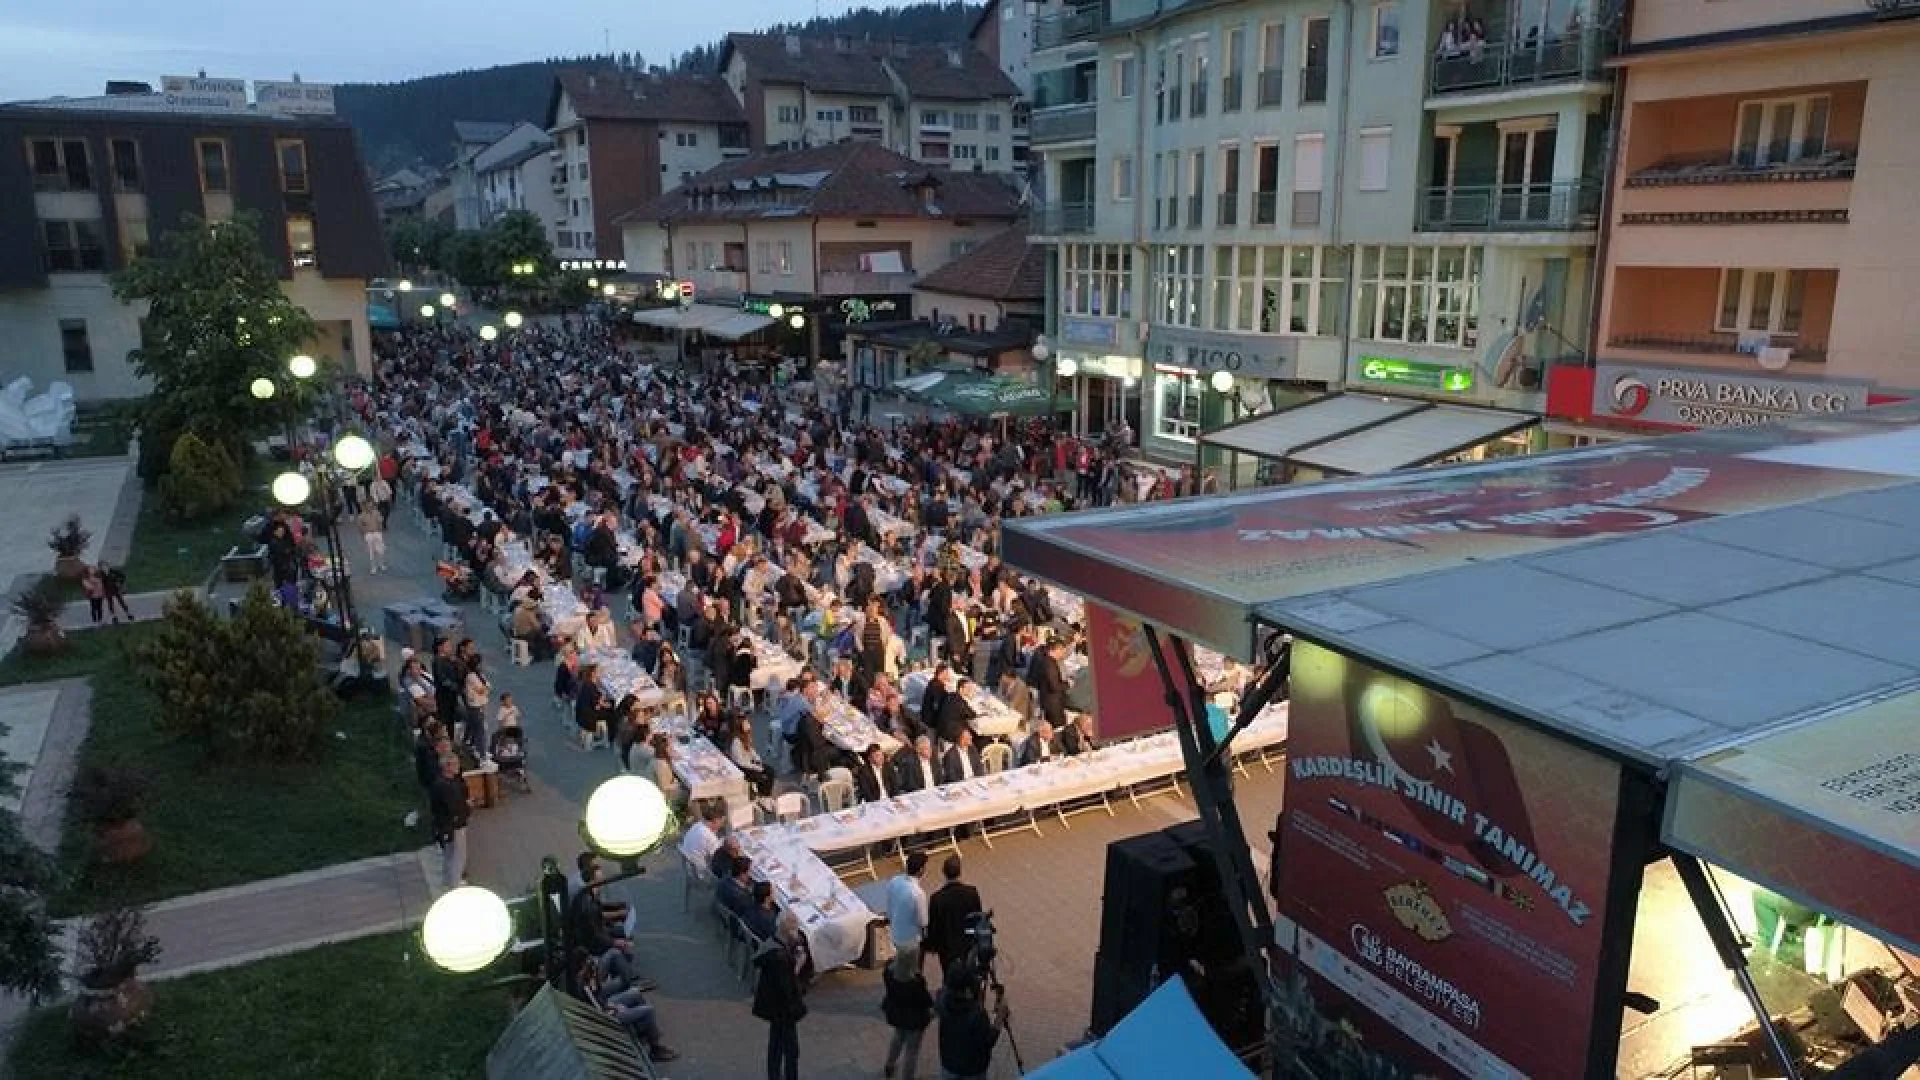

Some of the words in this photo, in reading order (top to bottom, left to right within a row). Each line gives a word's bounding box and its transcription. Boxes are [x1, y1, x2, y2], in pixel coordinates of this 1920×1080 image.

[1657, 377, 1709, 401] PRVA
[1717, 383, 1800, 411] BANKA
[1808, 391, 1845, 414] CG
[1473, 813, 1594, 927] TANIMAZ
